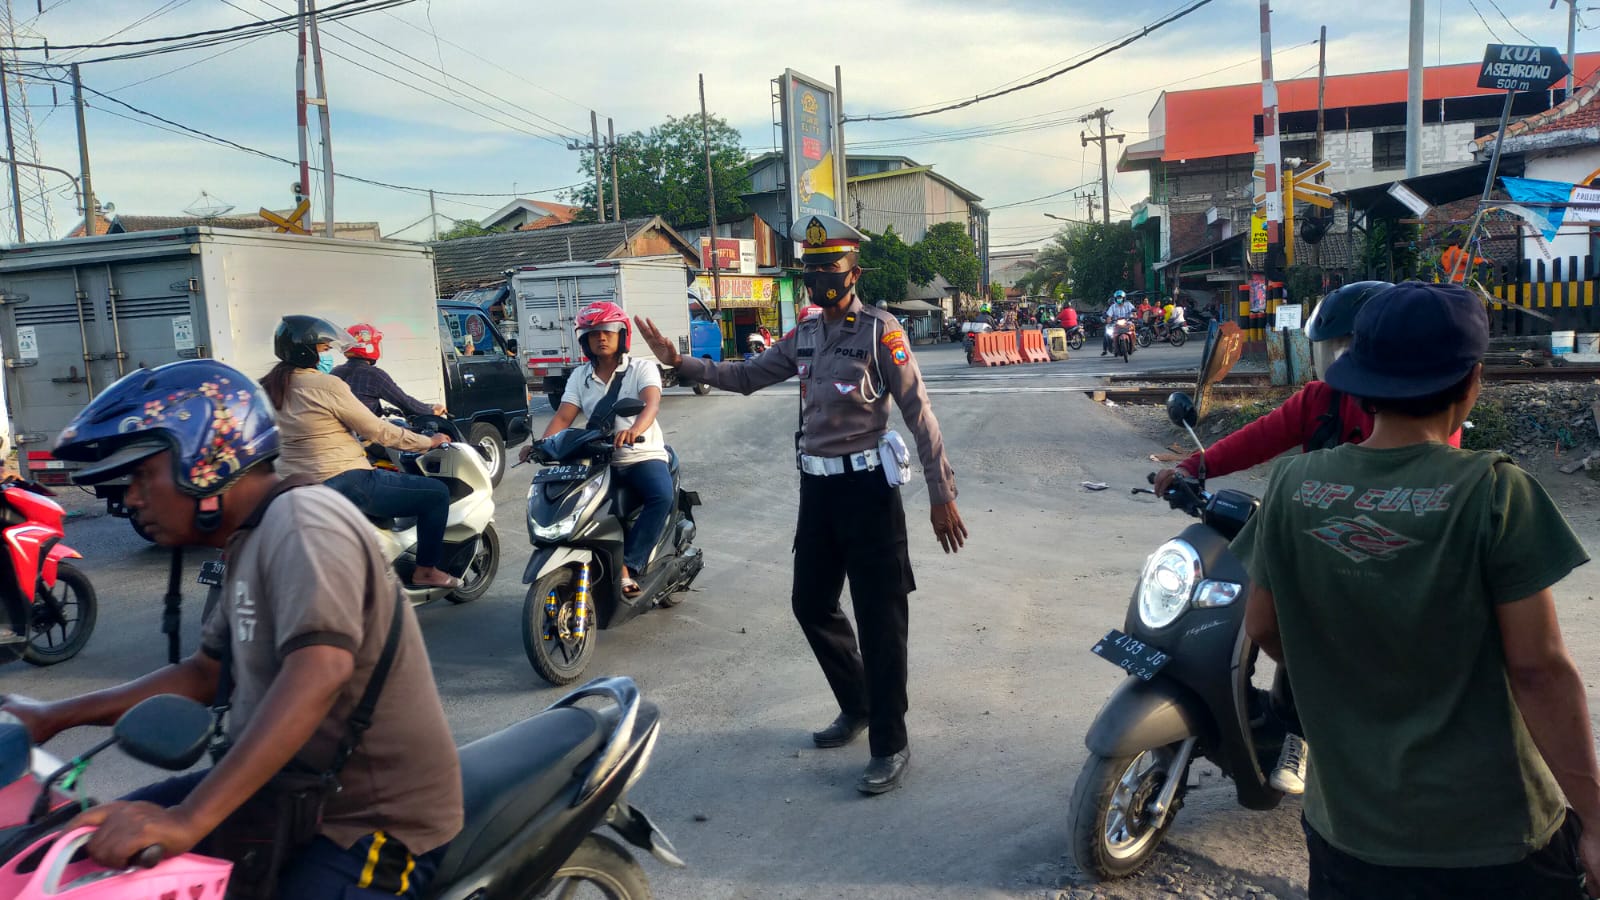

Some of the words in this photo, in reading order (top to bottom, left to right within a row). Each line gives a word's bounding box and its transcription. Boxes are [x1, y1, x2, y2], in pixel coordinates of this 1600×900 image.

[1500, 47, 1540, 62] KUA
[1484, 63, 1551, 79] ASEMROWO
[1497, 79, 1518, 89] 500
[1518, 82, 1530, 90] m
[834, 347, 869, 360] POLRI
[1292, 479, 1354, 509] RIP
[1354, 483, 1454, 516] CURL
[1114, 634, 1147, 655] 4135
